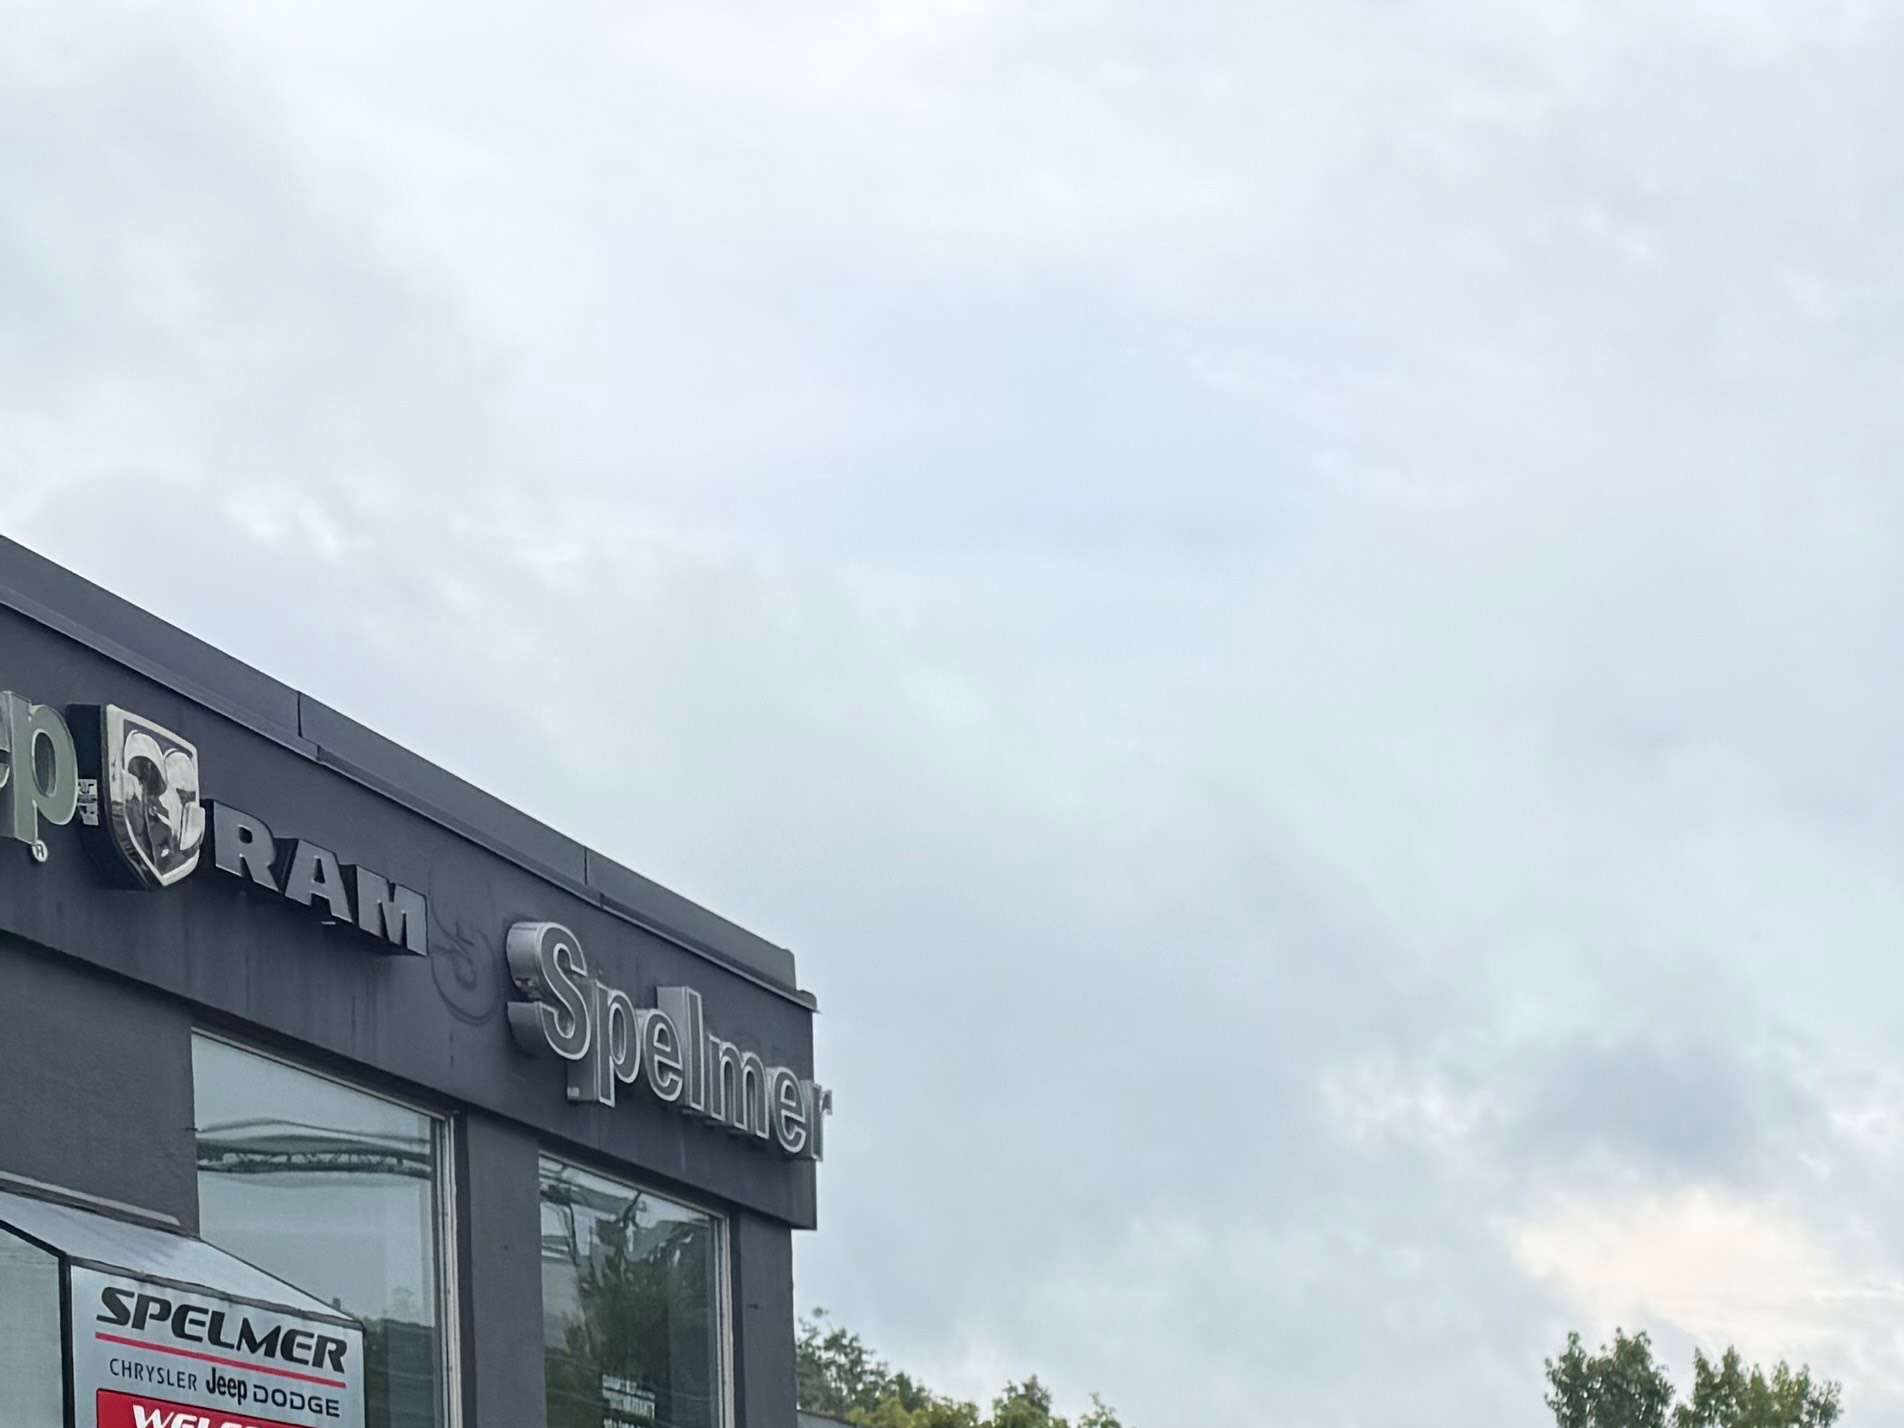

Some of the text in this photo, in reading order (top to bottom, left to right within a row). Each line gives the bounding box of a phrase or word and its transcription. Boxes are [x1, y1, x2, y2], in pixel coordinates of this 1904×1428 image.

[212, 800, 428, 957] RAM
[506, 922, 832, 1162] Spelmer
[96, 1286, 348, 1374] SPELMER
[109, 1358, 341, 1418] CHRYSLER Jeep DODGE
